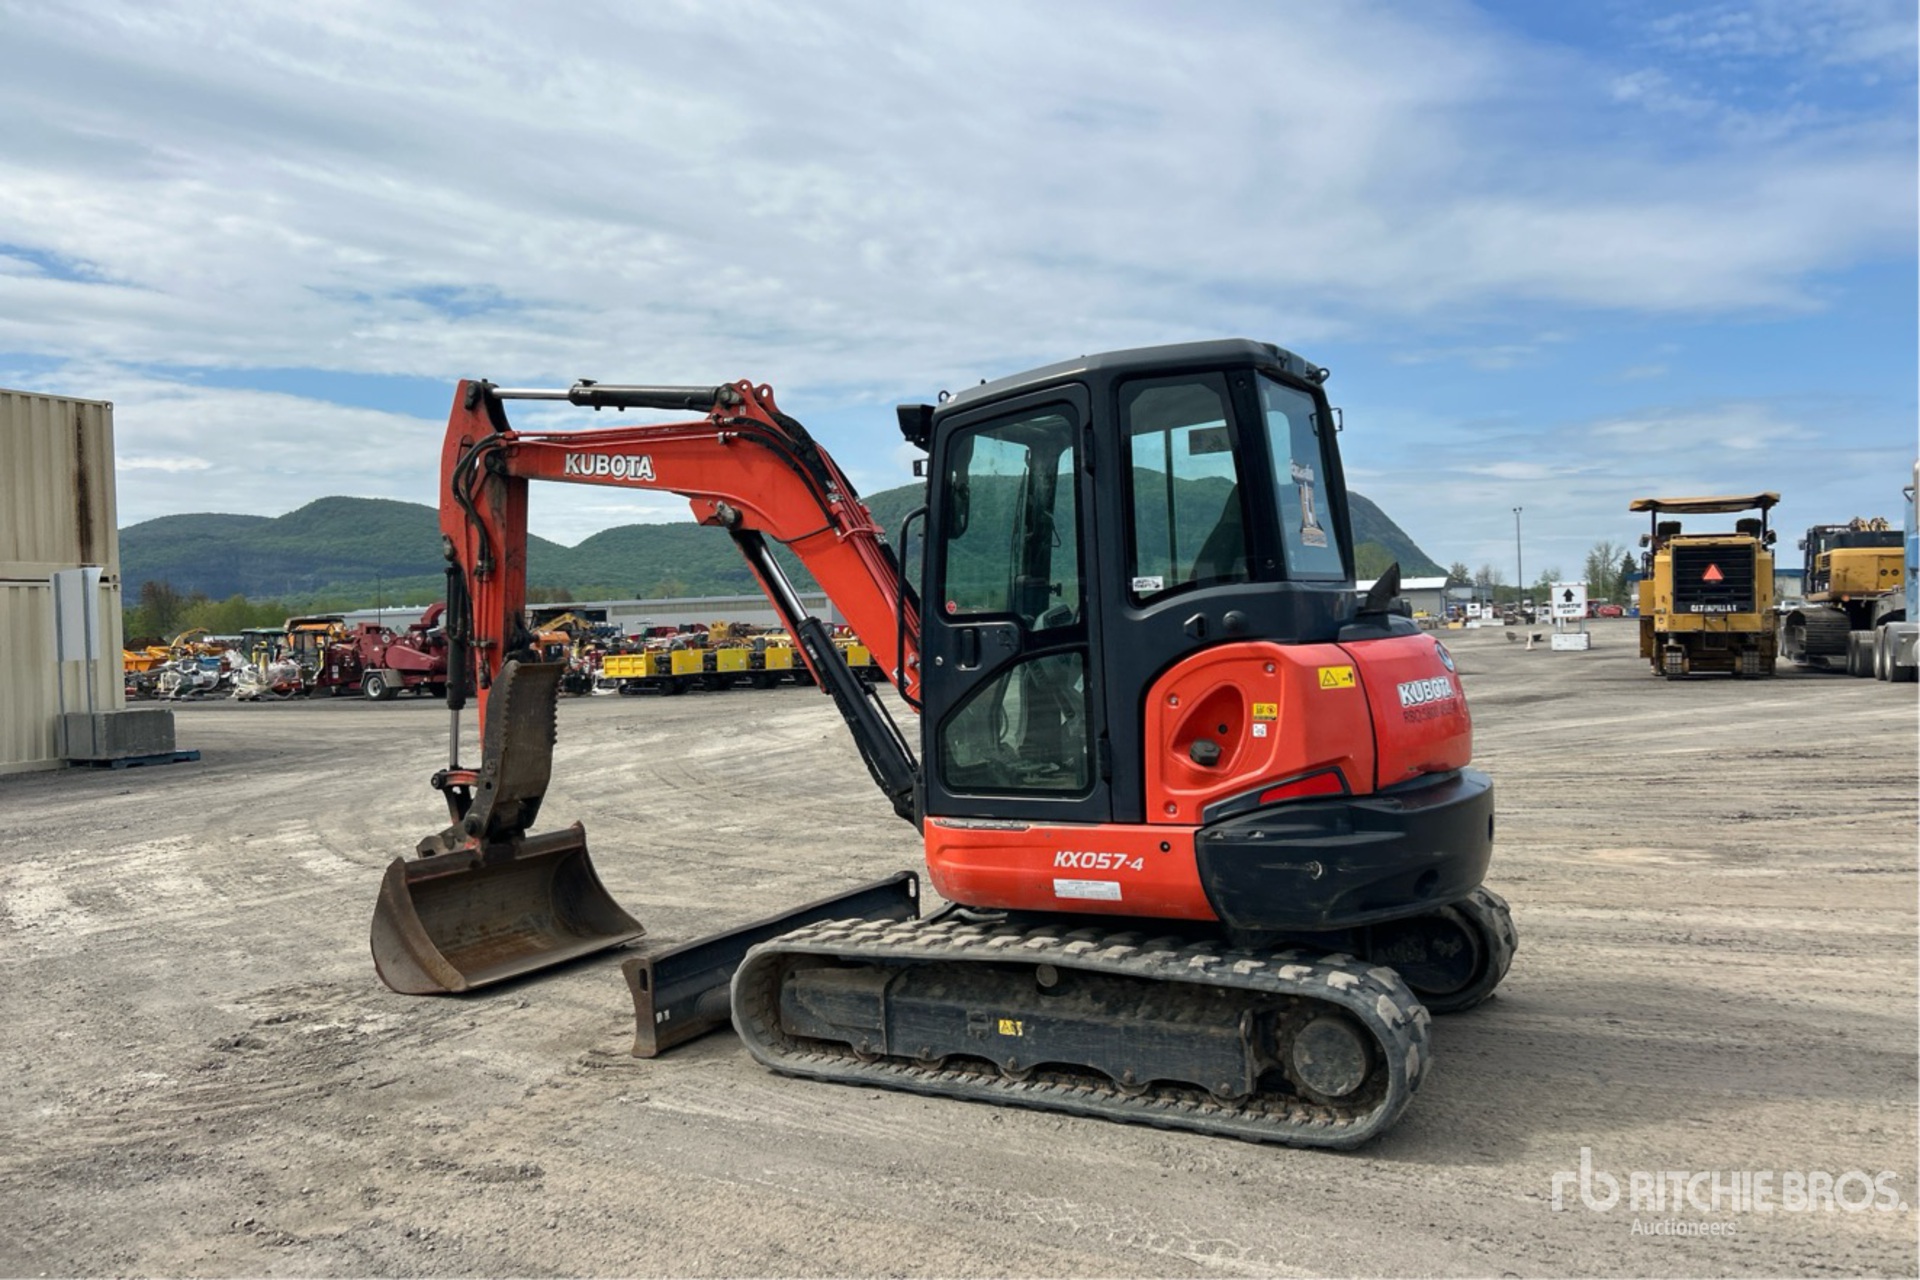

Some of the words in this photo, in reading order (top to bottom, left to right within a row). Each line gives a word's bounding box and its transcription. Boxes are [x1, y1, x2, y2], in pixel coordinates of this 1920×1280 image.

[564, 453, 654, 479] KUBOTA
[1398, 676, 1454, 706] KUBOTA
[1053, 850, 1144, 871] KX057-4
